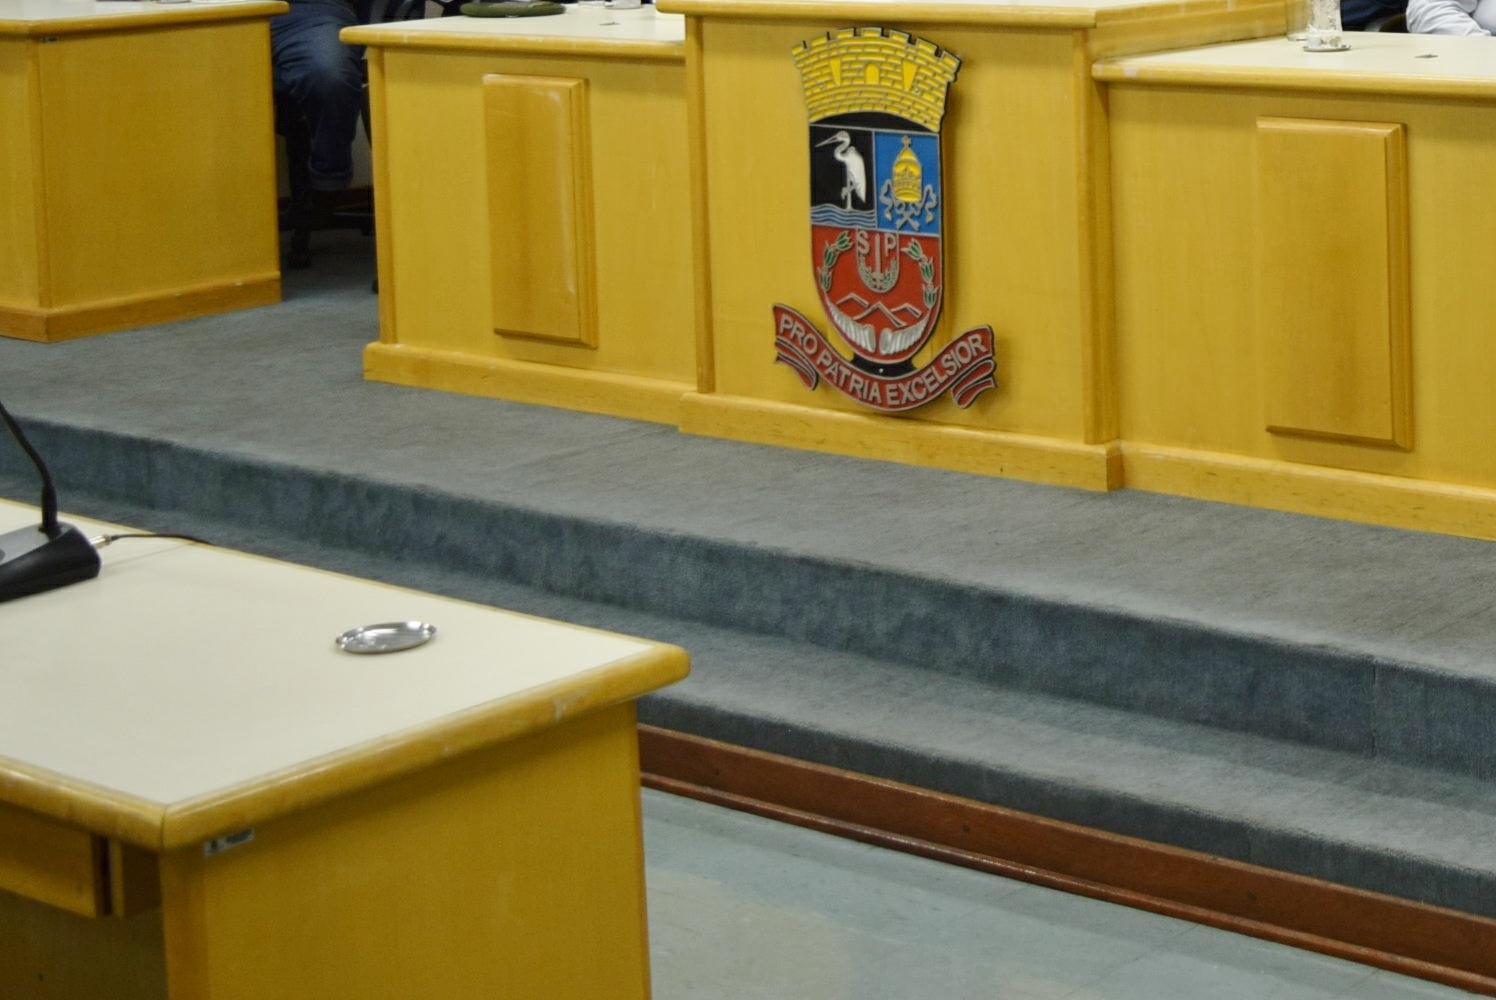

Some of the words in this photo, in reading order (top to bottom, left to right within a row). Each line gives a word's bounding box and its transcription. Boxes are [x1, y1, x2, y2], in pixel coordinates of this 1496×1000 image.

[778, 314, 818, 355] PRO
[816, 351, 881, 403] PATRIA
[886, 333, 986, 405] EXCELSIOR
